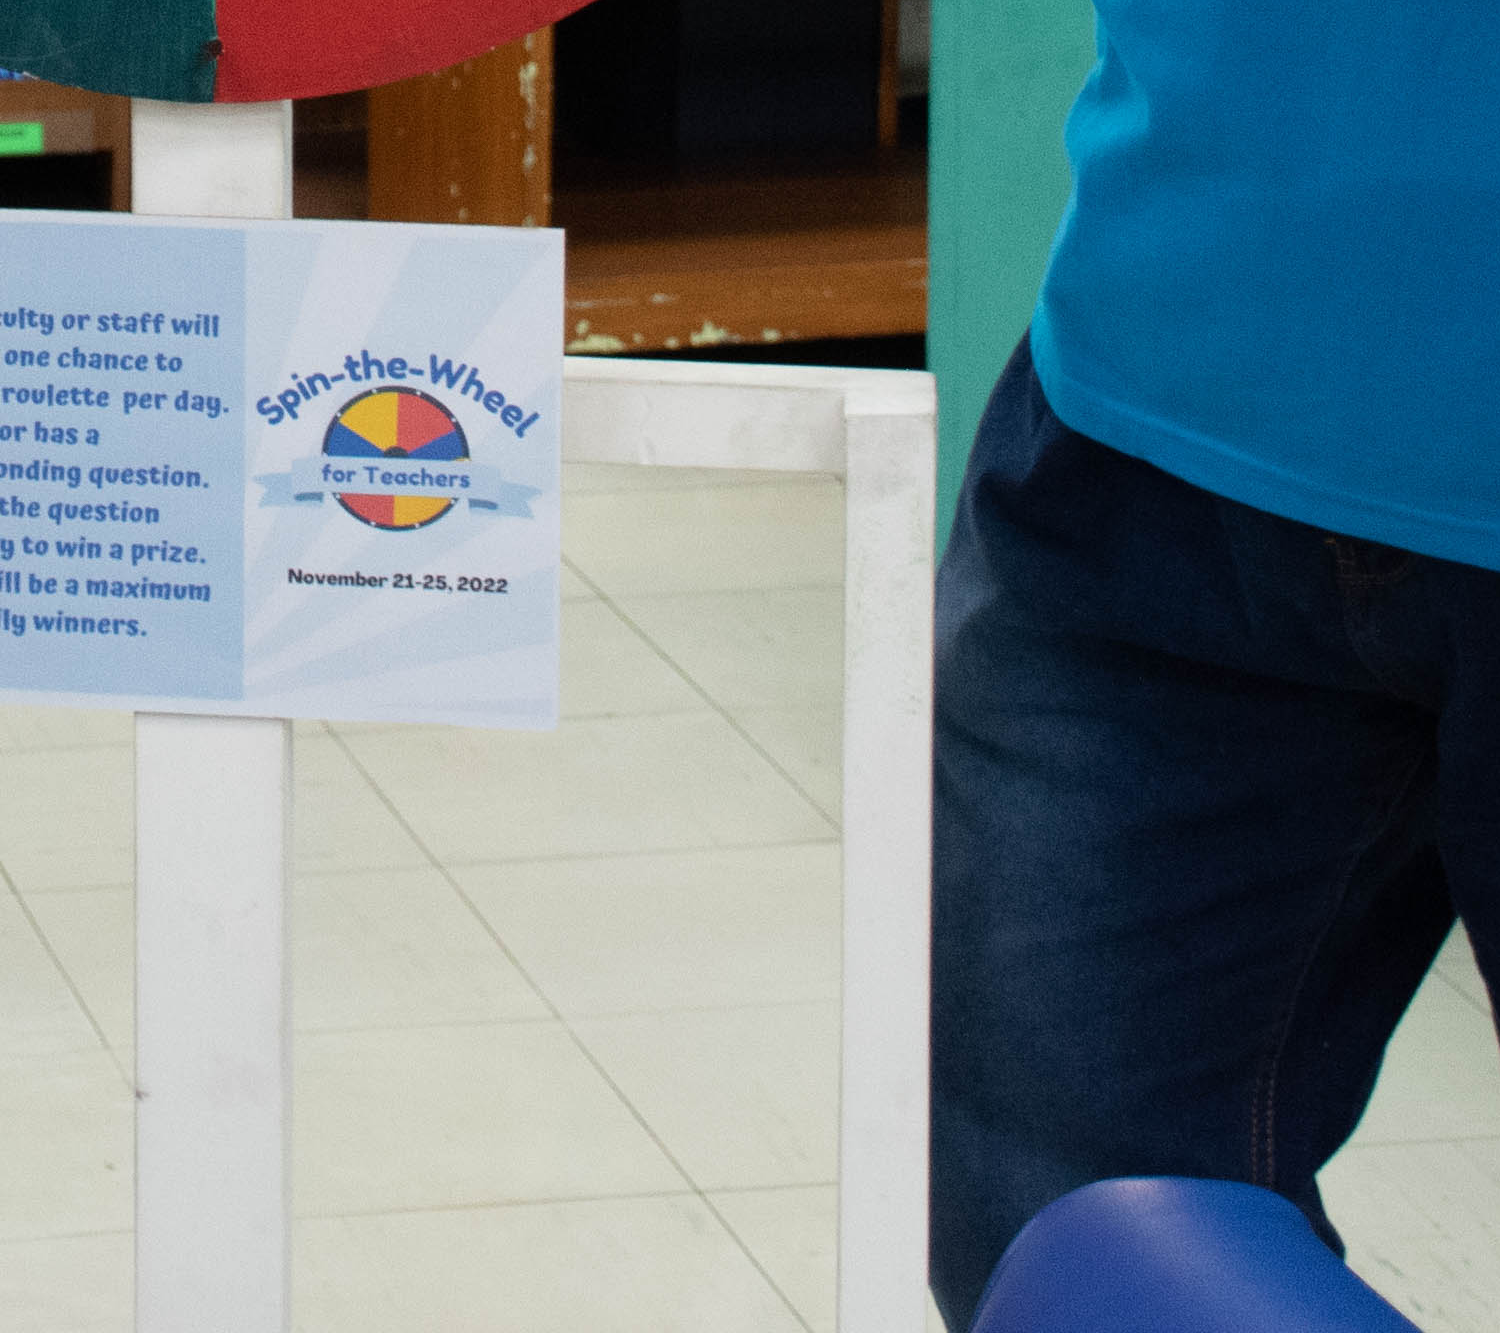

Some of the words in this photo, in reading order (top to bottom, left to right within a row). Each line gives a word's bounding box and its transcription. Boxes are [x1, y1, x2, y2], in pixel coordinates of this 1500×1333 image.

[62, 313, 91, 331] or
[97, 312, 166, 334] staff
[171, 314, 220, 337] will
[4, 349, 50, 367] one
[57, 347, 149, 371] chance
[155, 352, 183, 372] to
[2, 384, 110, 408] roulette
[122, 390, 167, 414] per
[174, 390, 230, 418] day.
[256, 349, 540, 439] Spin-the-Wheel
[34, 420, 78, 445] has
[85, 428, 100, 445] a
[88, 464, 209, 490] question.
[321, 463, 357, 482] for
[364, 466, 471, 489] Teachers
[48, 501, 160, 525] question
[22, 536, 49, 555] to
[55, 536, 102, 559] win
[109, 543, 123, 560] a
[131, 540, 206, 566] prize.
[28, 573, 58, 595] be
[65, 579, 79, 595] a
[86, 576, 211, 602] maximum
[288, 568, 388, 589] November
[392, 573, 453, 592] 21-25,
[457, 576, 509, 594] 2022
[33, 610, 147, 637] winners.
